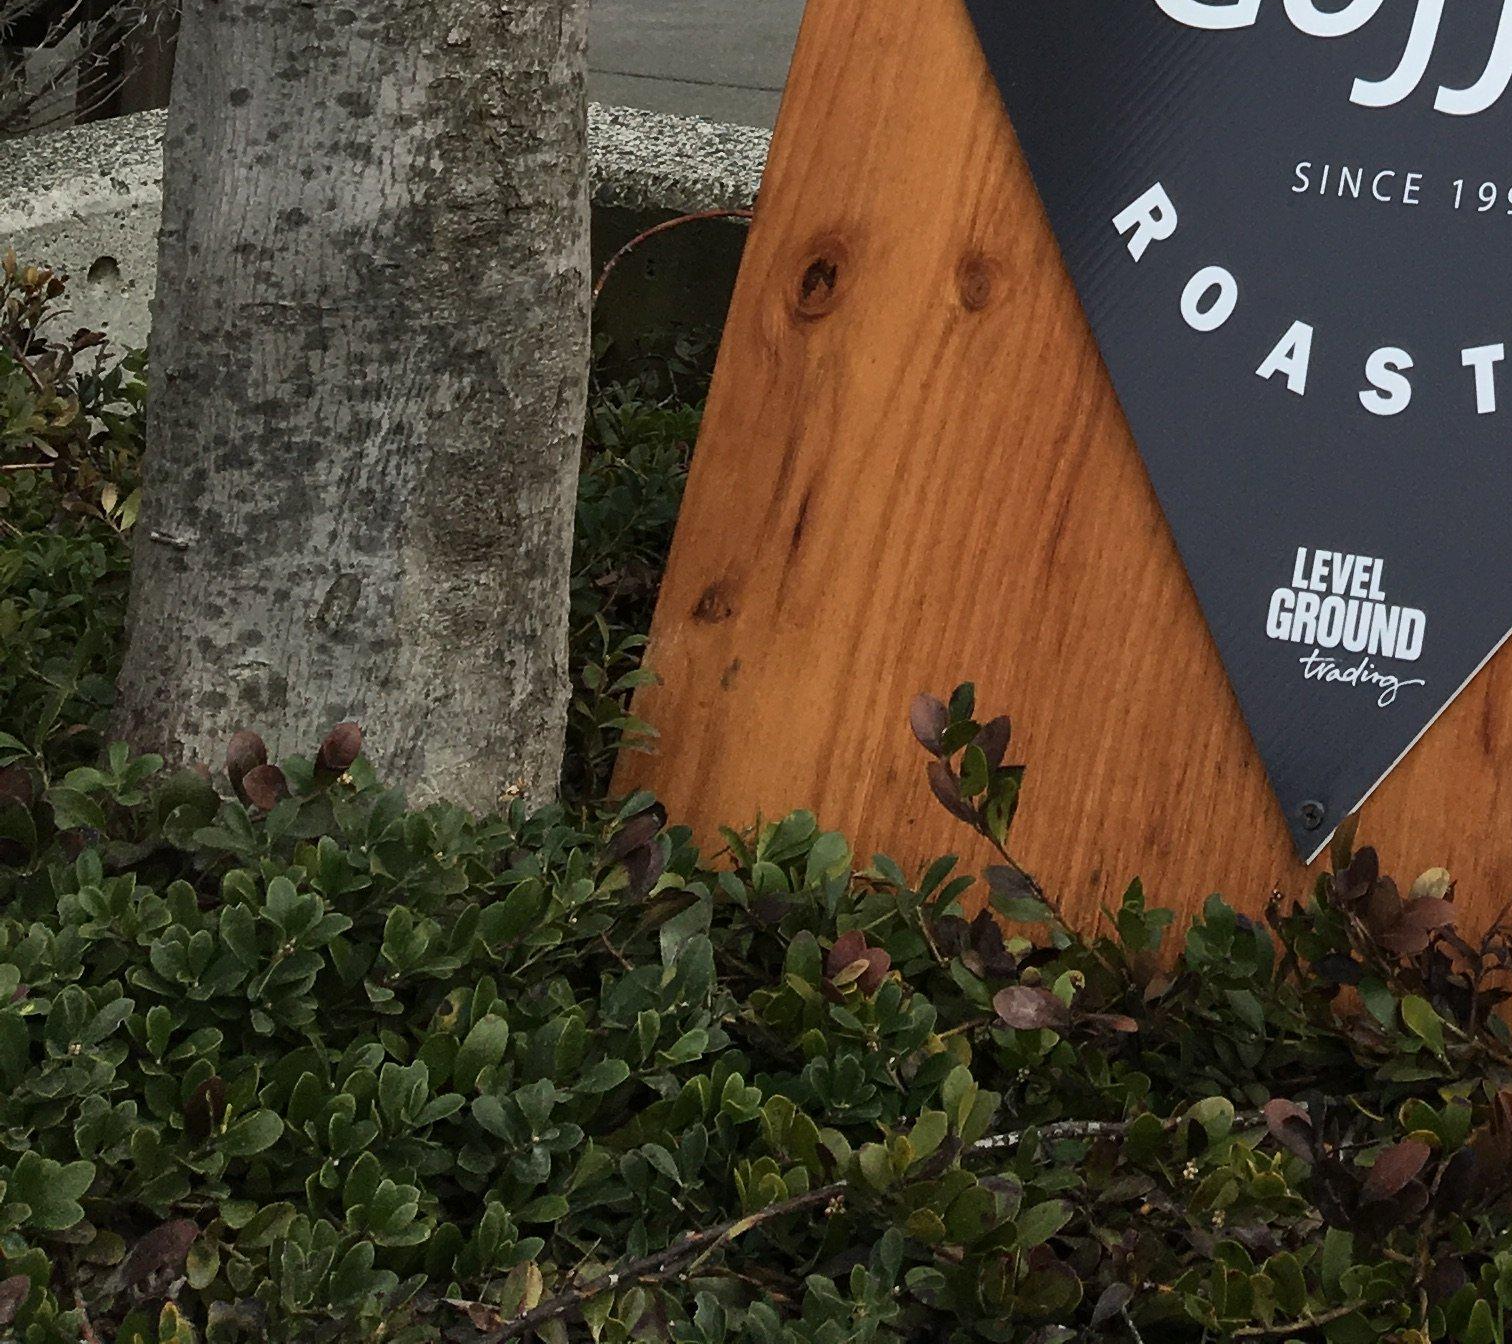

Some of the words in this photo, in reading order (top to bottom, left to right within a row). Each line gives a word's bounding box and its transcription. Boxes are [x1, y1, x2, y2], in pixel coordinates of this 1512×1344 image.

[1291, 161, 1424, 205] SINCE
[1291, 546, 1386, 602] LEVEL
[1265, 587, 1426, 661] GROUND
[1299, 648, 1426, 708] trading
